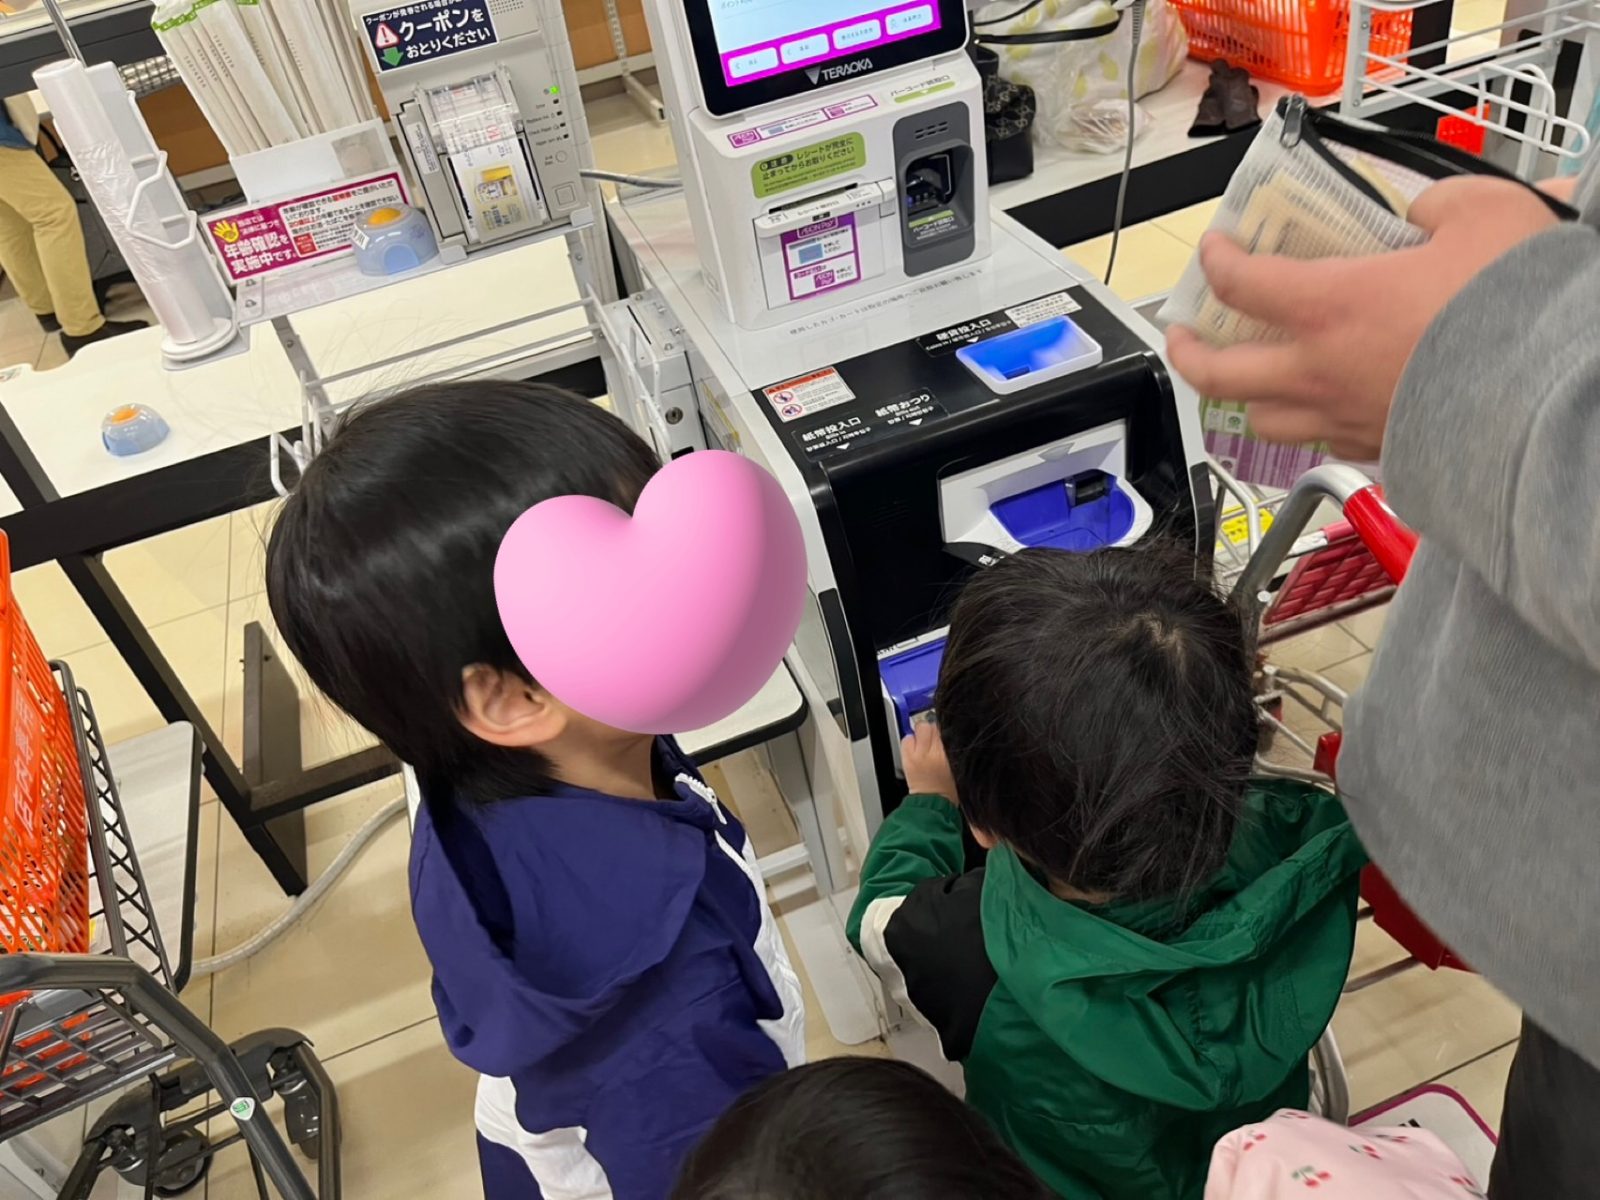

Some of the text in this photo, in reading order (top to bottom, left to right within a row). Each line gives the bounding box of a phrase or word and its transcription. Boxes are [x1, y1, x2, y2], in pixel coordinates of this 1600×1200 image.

[399, 8, 485, 41] クーポンを
[405, 27, 491, 59] おとりください
[821, 57, 873, 81] TERAOKA
[224, 231, 289, 259] 年齢確認を
[936, 318, 992, 341] 硬貨投入口
[874, 394, 930, 417] 紙幣おつり
[802, 416, 861, 442] 紙幣投入口
